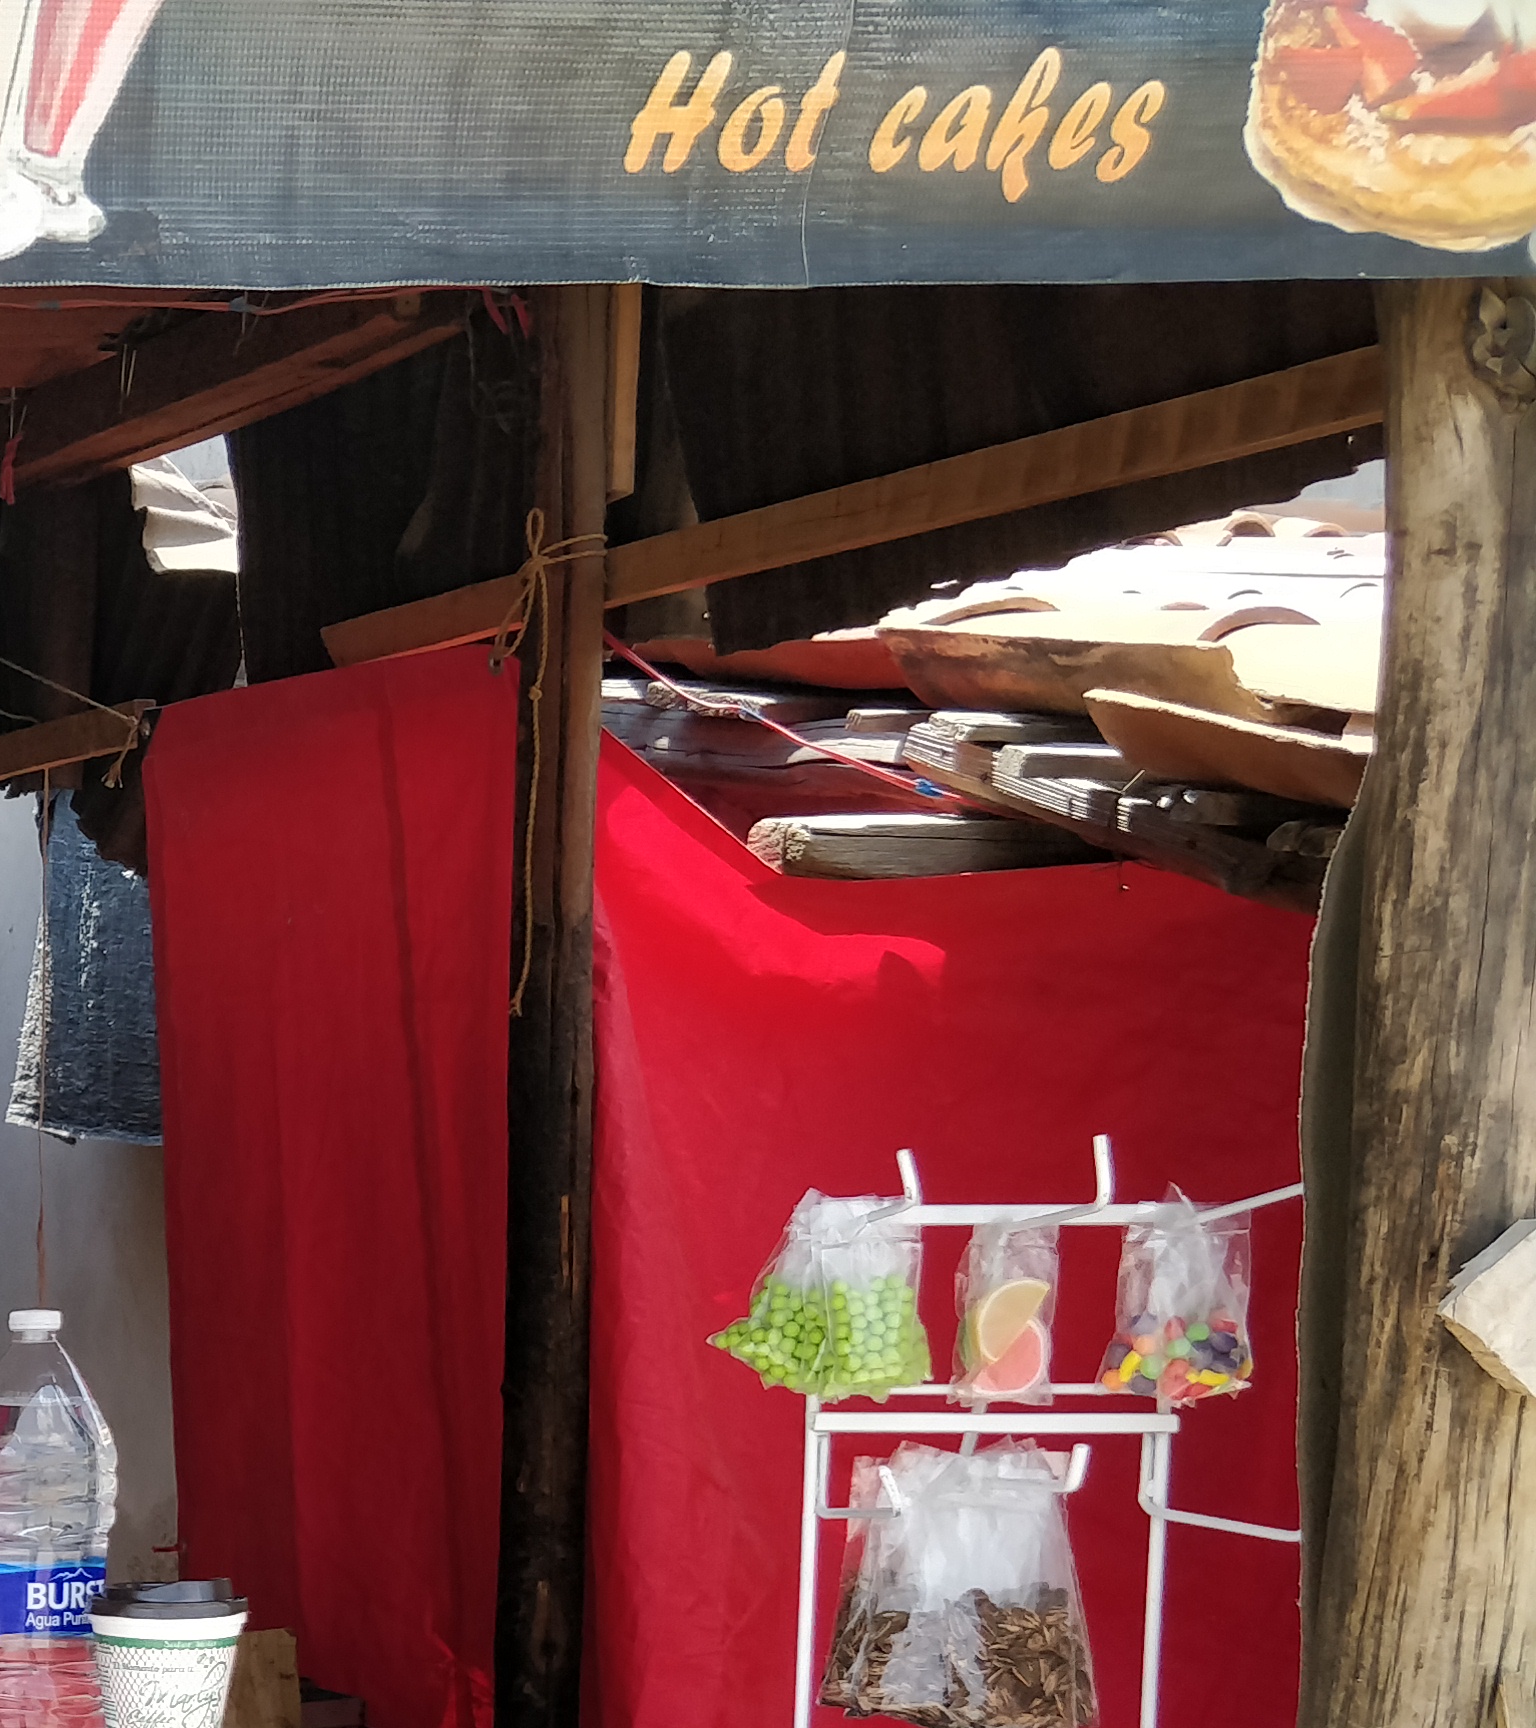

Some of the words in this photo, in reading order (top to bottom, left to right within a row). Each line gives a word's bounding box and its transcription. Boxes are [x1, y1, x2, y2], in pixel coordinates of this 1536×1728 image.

[622, 50, 846, 174] Hot
[868, 45, 1166, 204] cakes
[25, 1611, 61, 1630] Agua
